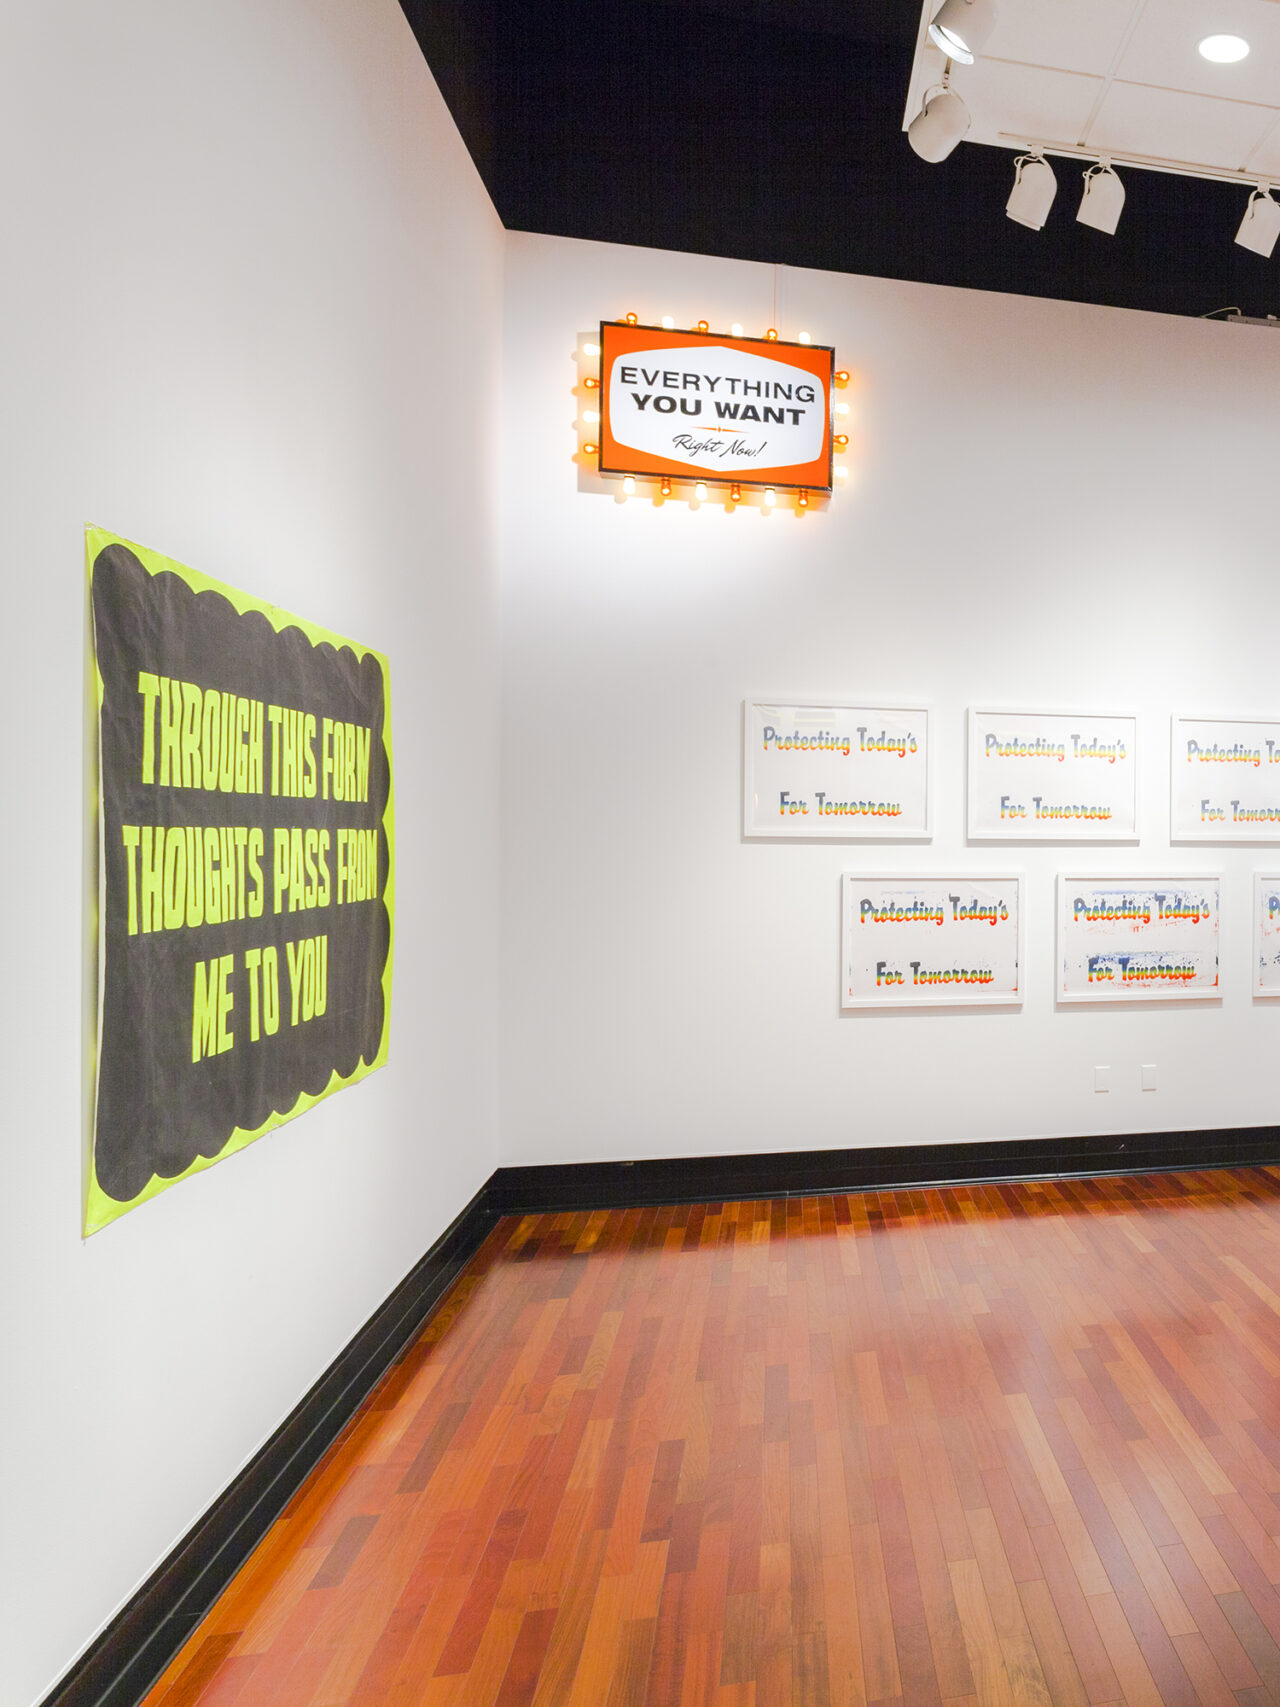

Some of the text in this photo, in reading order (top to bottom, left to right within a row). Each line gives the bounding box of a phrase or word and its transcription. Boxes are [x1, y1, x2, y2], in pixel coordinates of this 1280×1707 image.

[620, 366, 816, 403] EVERYTHING
[631, 393, 806, 426] YOU WANT
[672, 434, 768, 458] Right Now!
[138, 671, 372, 803] THROUGH THIS FORM
[763, 726, 918, 759] Protecting Today's
[985, 733, 1127, 764] Protecting Today's
[1187, 739, 1261, 768] Protecting
[779, 790, 902, 817] For Tomorrow
[1000, 796, 1113, 821] For Tomorrow
[1201, 799, 1226, 822] For
[121, 825, 379, 936] THOUGHTS PASS FROM
[860, 894, 1009, 926] Protecting Today's
[1073, 895, 1211, 924] Protecting Today's
[876, 961, 995, 987] For Tomorrow
[1087, 957, 1197, 983] For Tomorrow
[191, 935, 329, 1064] ME TO YOU
